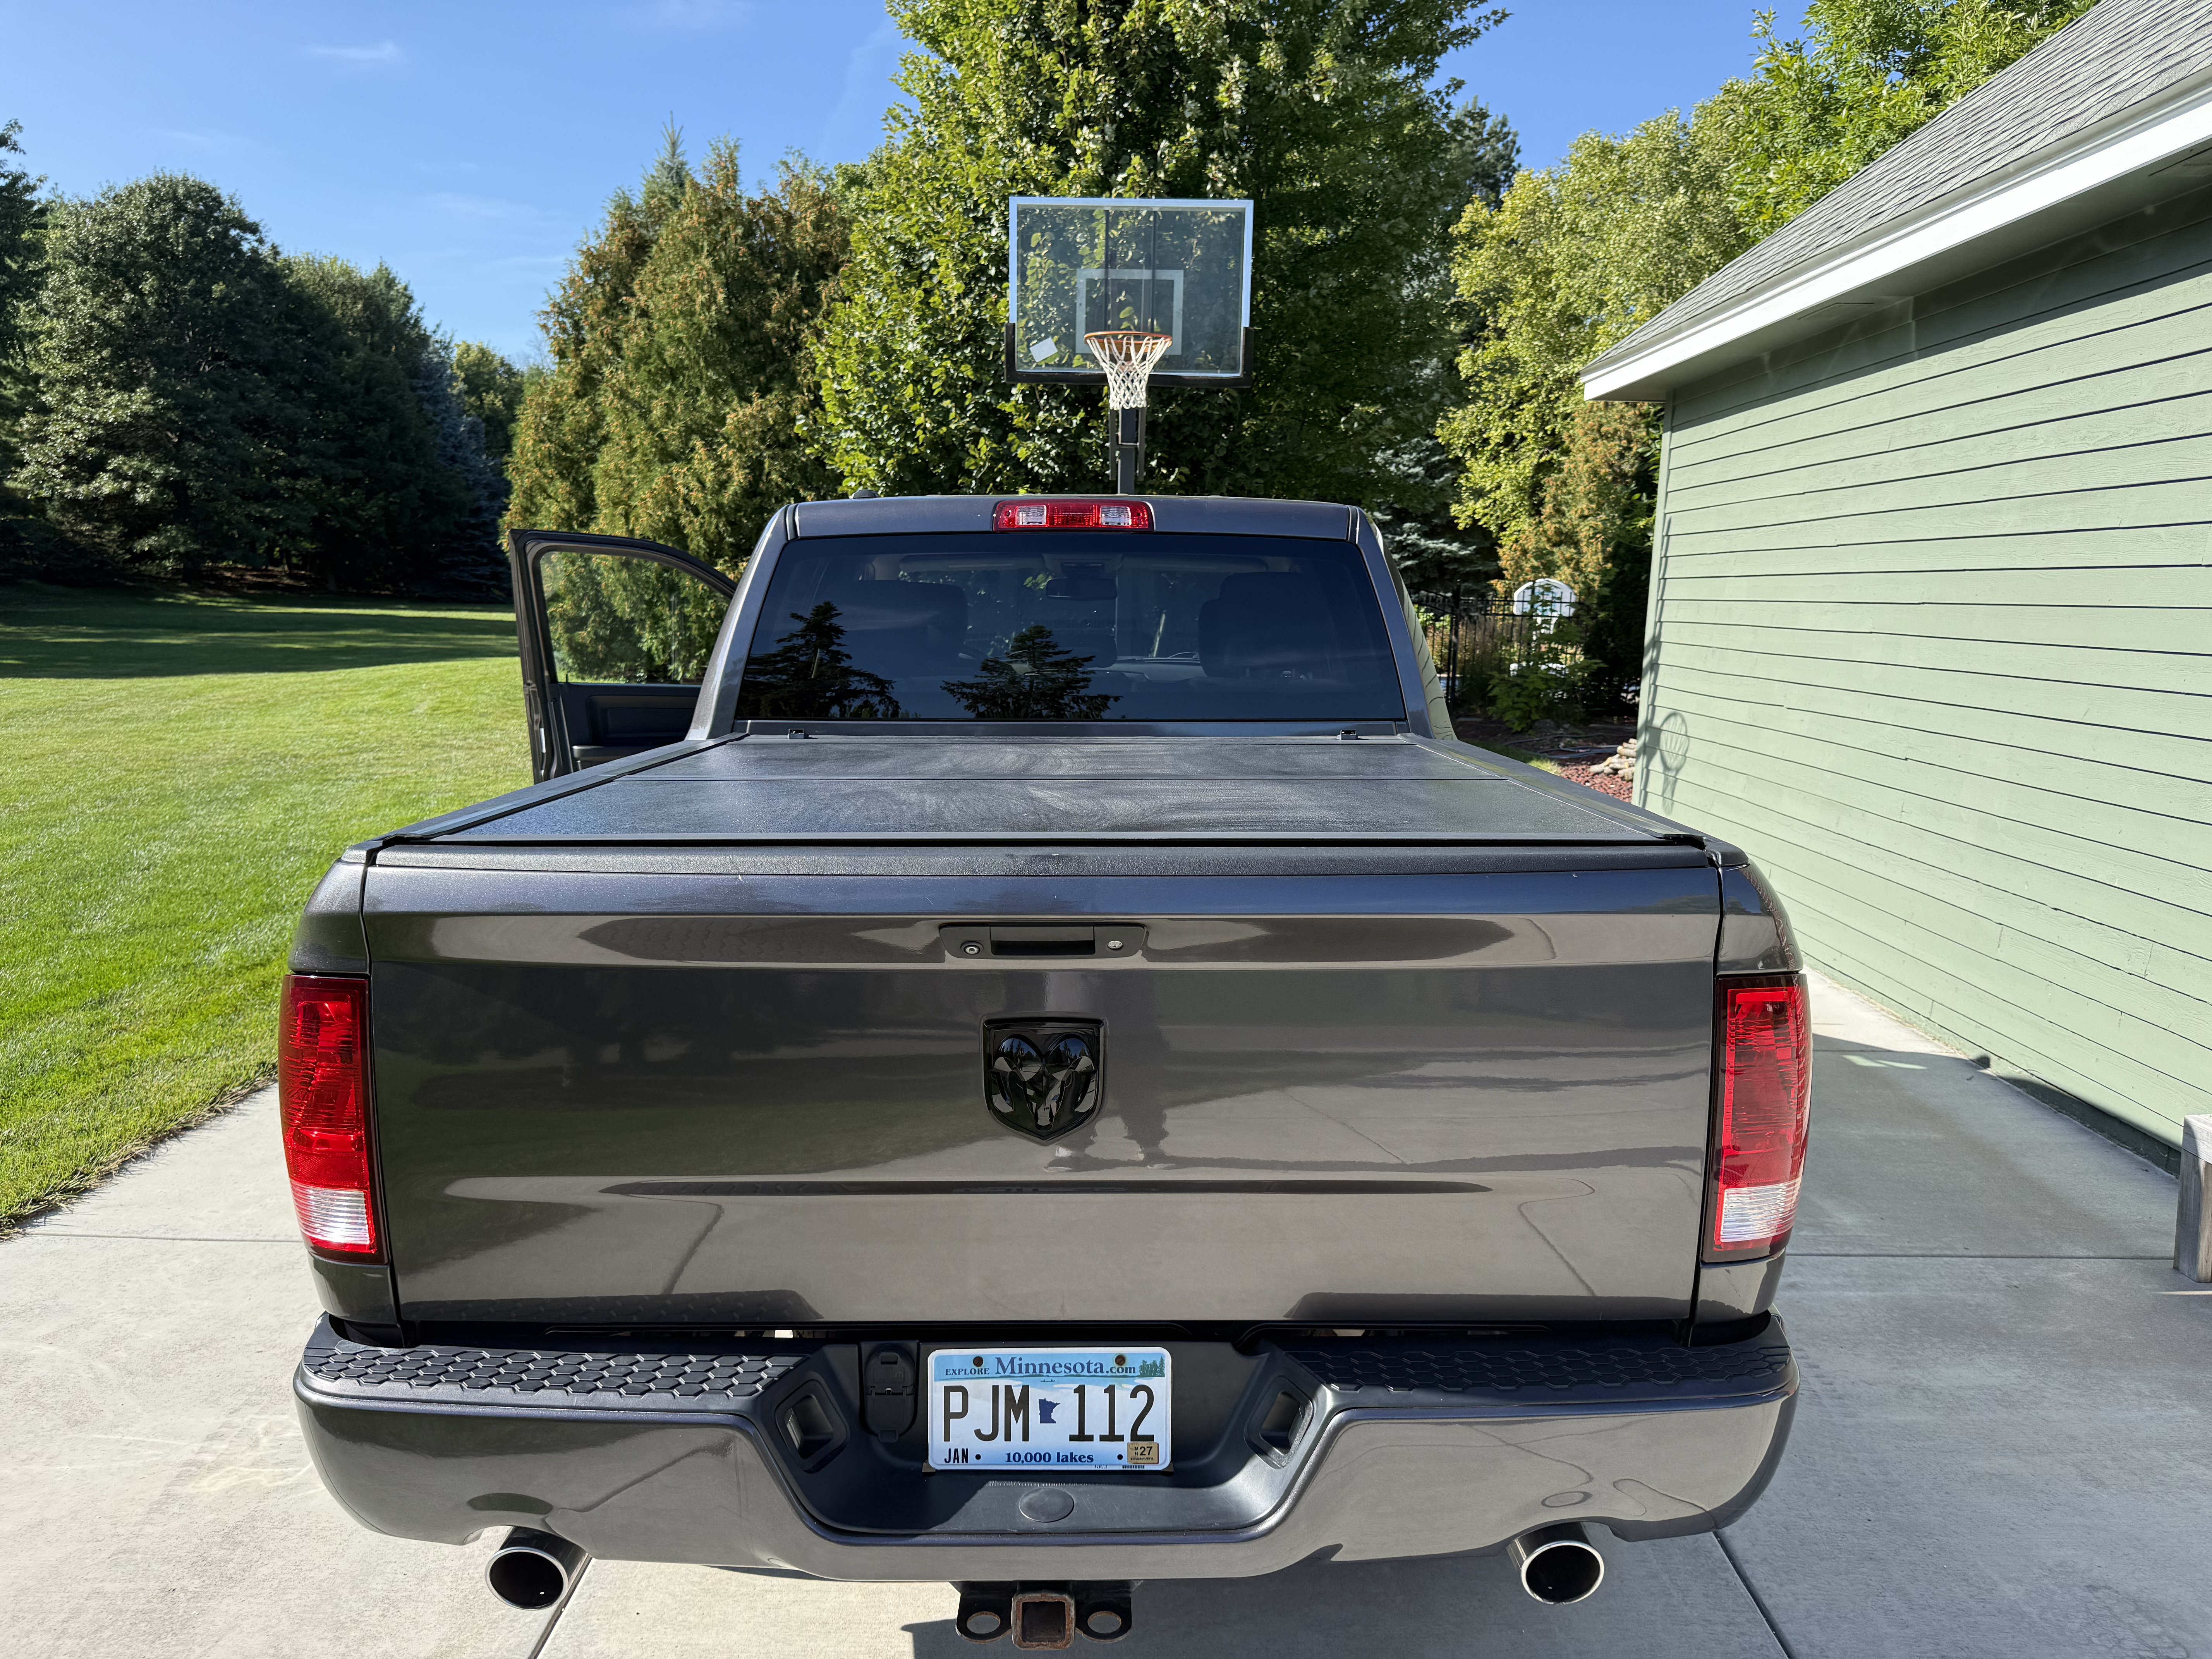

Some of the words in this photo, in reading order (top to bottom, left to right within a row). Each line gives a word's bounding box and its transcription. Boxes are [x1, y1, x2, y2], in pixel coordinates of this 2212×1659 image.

[945, 1367, 990, 1376] EXPLORE
[995, 1356, 1136, 1374] Minnesota.com
[943, 1384, 1029, 1442] PJM
[1068, 1384, 1155, 1442] 112
[944, 1448, 969, 1464] JAN
[1005, 1452, 1052, 1465] 10,000
[1056, 1451, 1094, 1463] lakes
[1139, 1446, 1153, 1456] 27
